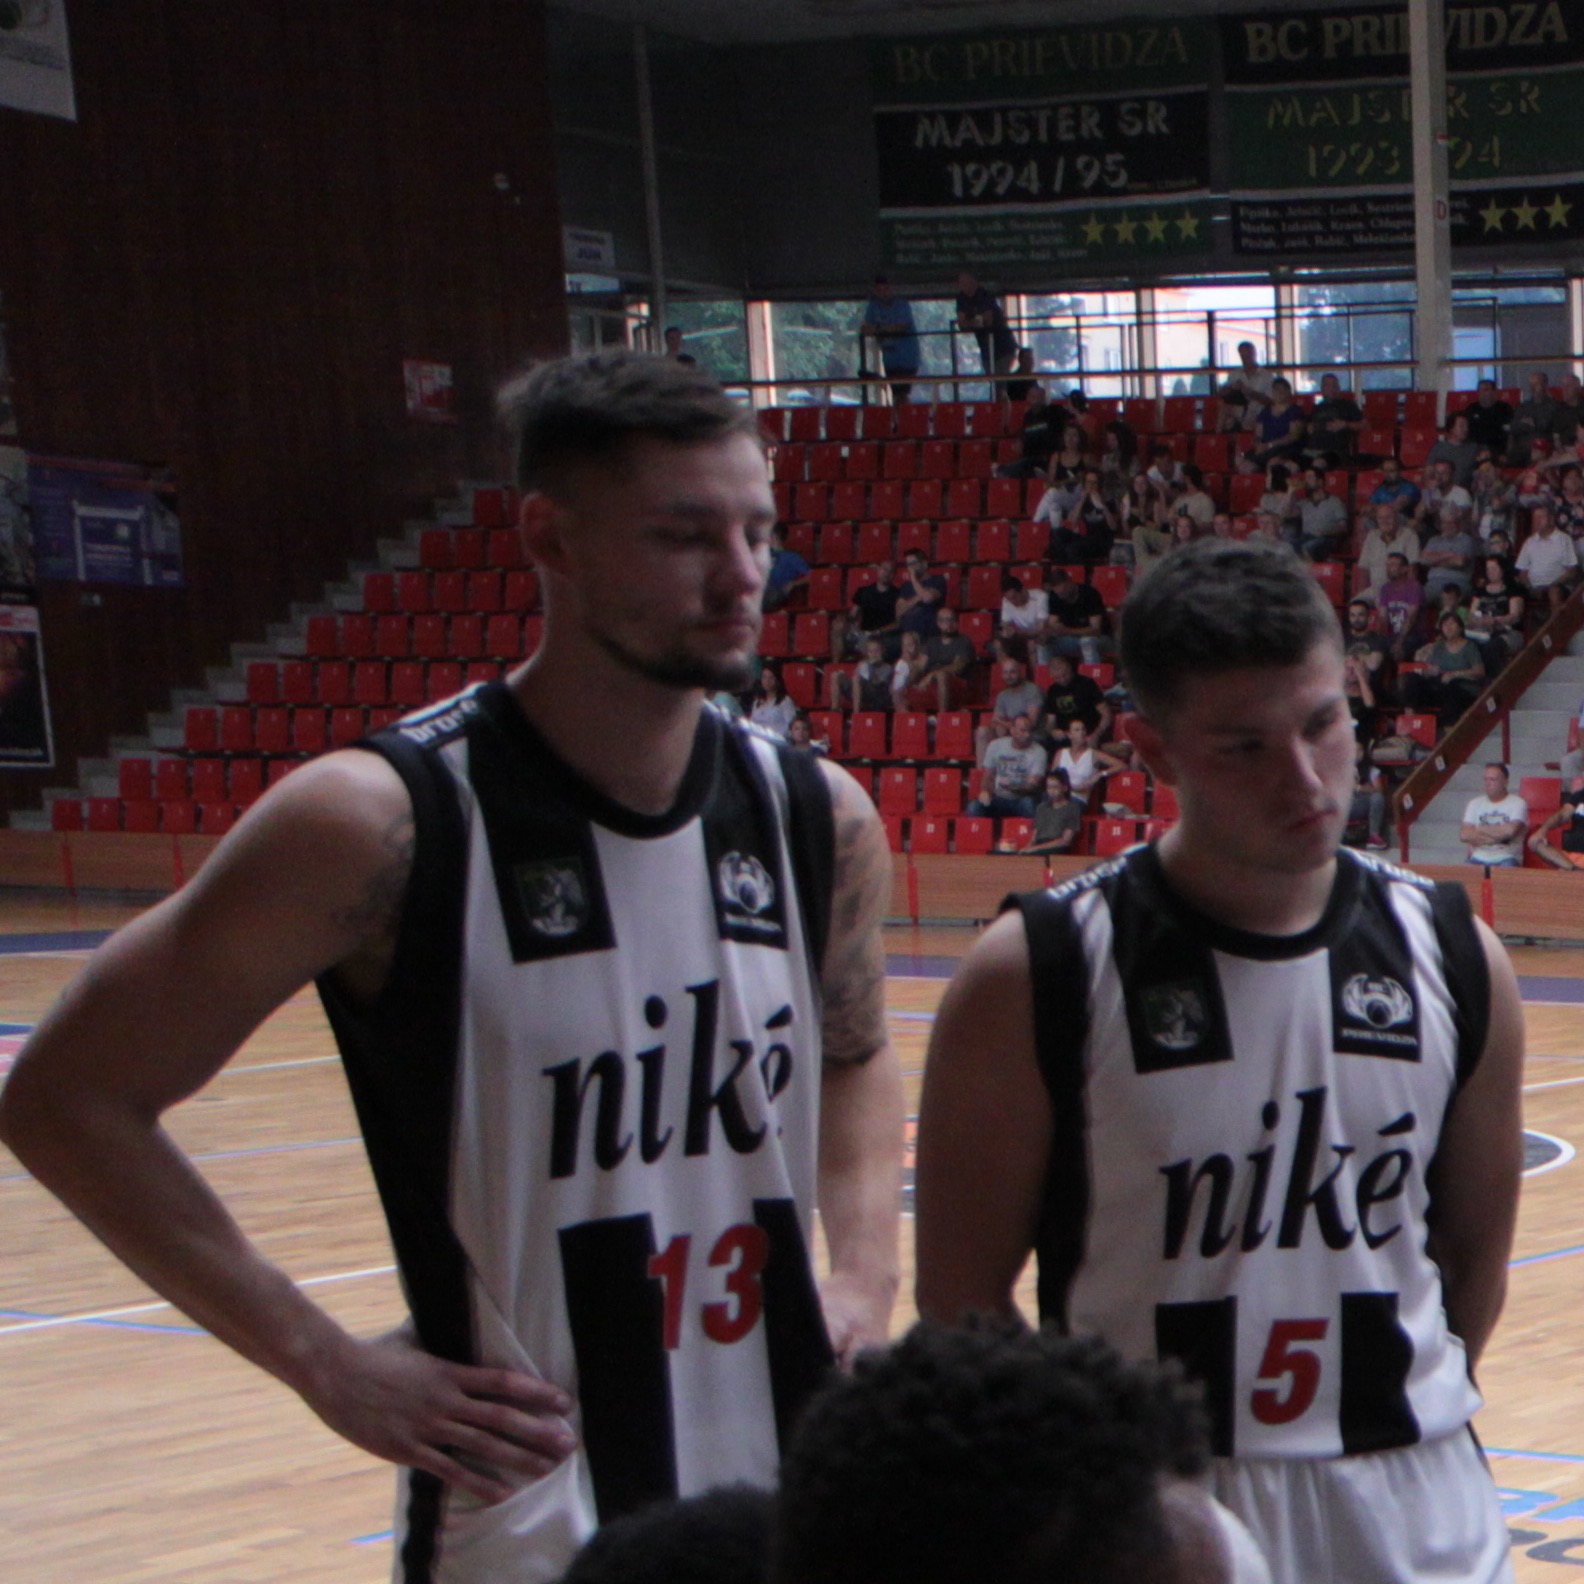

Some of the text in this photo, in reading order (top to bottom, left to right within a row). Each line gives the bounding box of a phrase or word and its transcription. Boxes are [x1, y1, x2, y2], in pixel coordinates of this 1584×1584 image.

[891, 25, 1190, 82] BC PRIEVIDZA
[1244, 19, 1308, 63] BC
[914, 100, 1170, 150] MAJSTER SR
[1488, 80, 1542, 116] SR
[542, 980, 793, 1180] niké
[1159, 1087, 1417, 1259] niké
[646, 1224, 770, 1350] 13
[1251, 1318, 1330, 1425] 5
